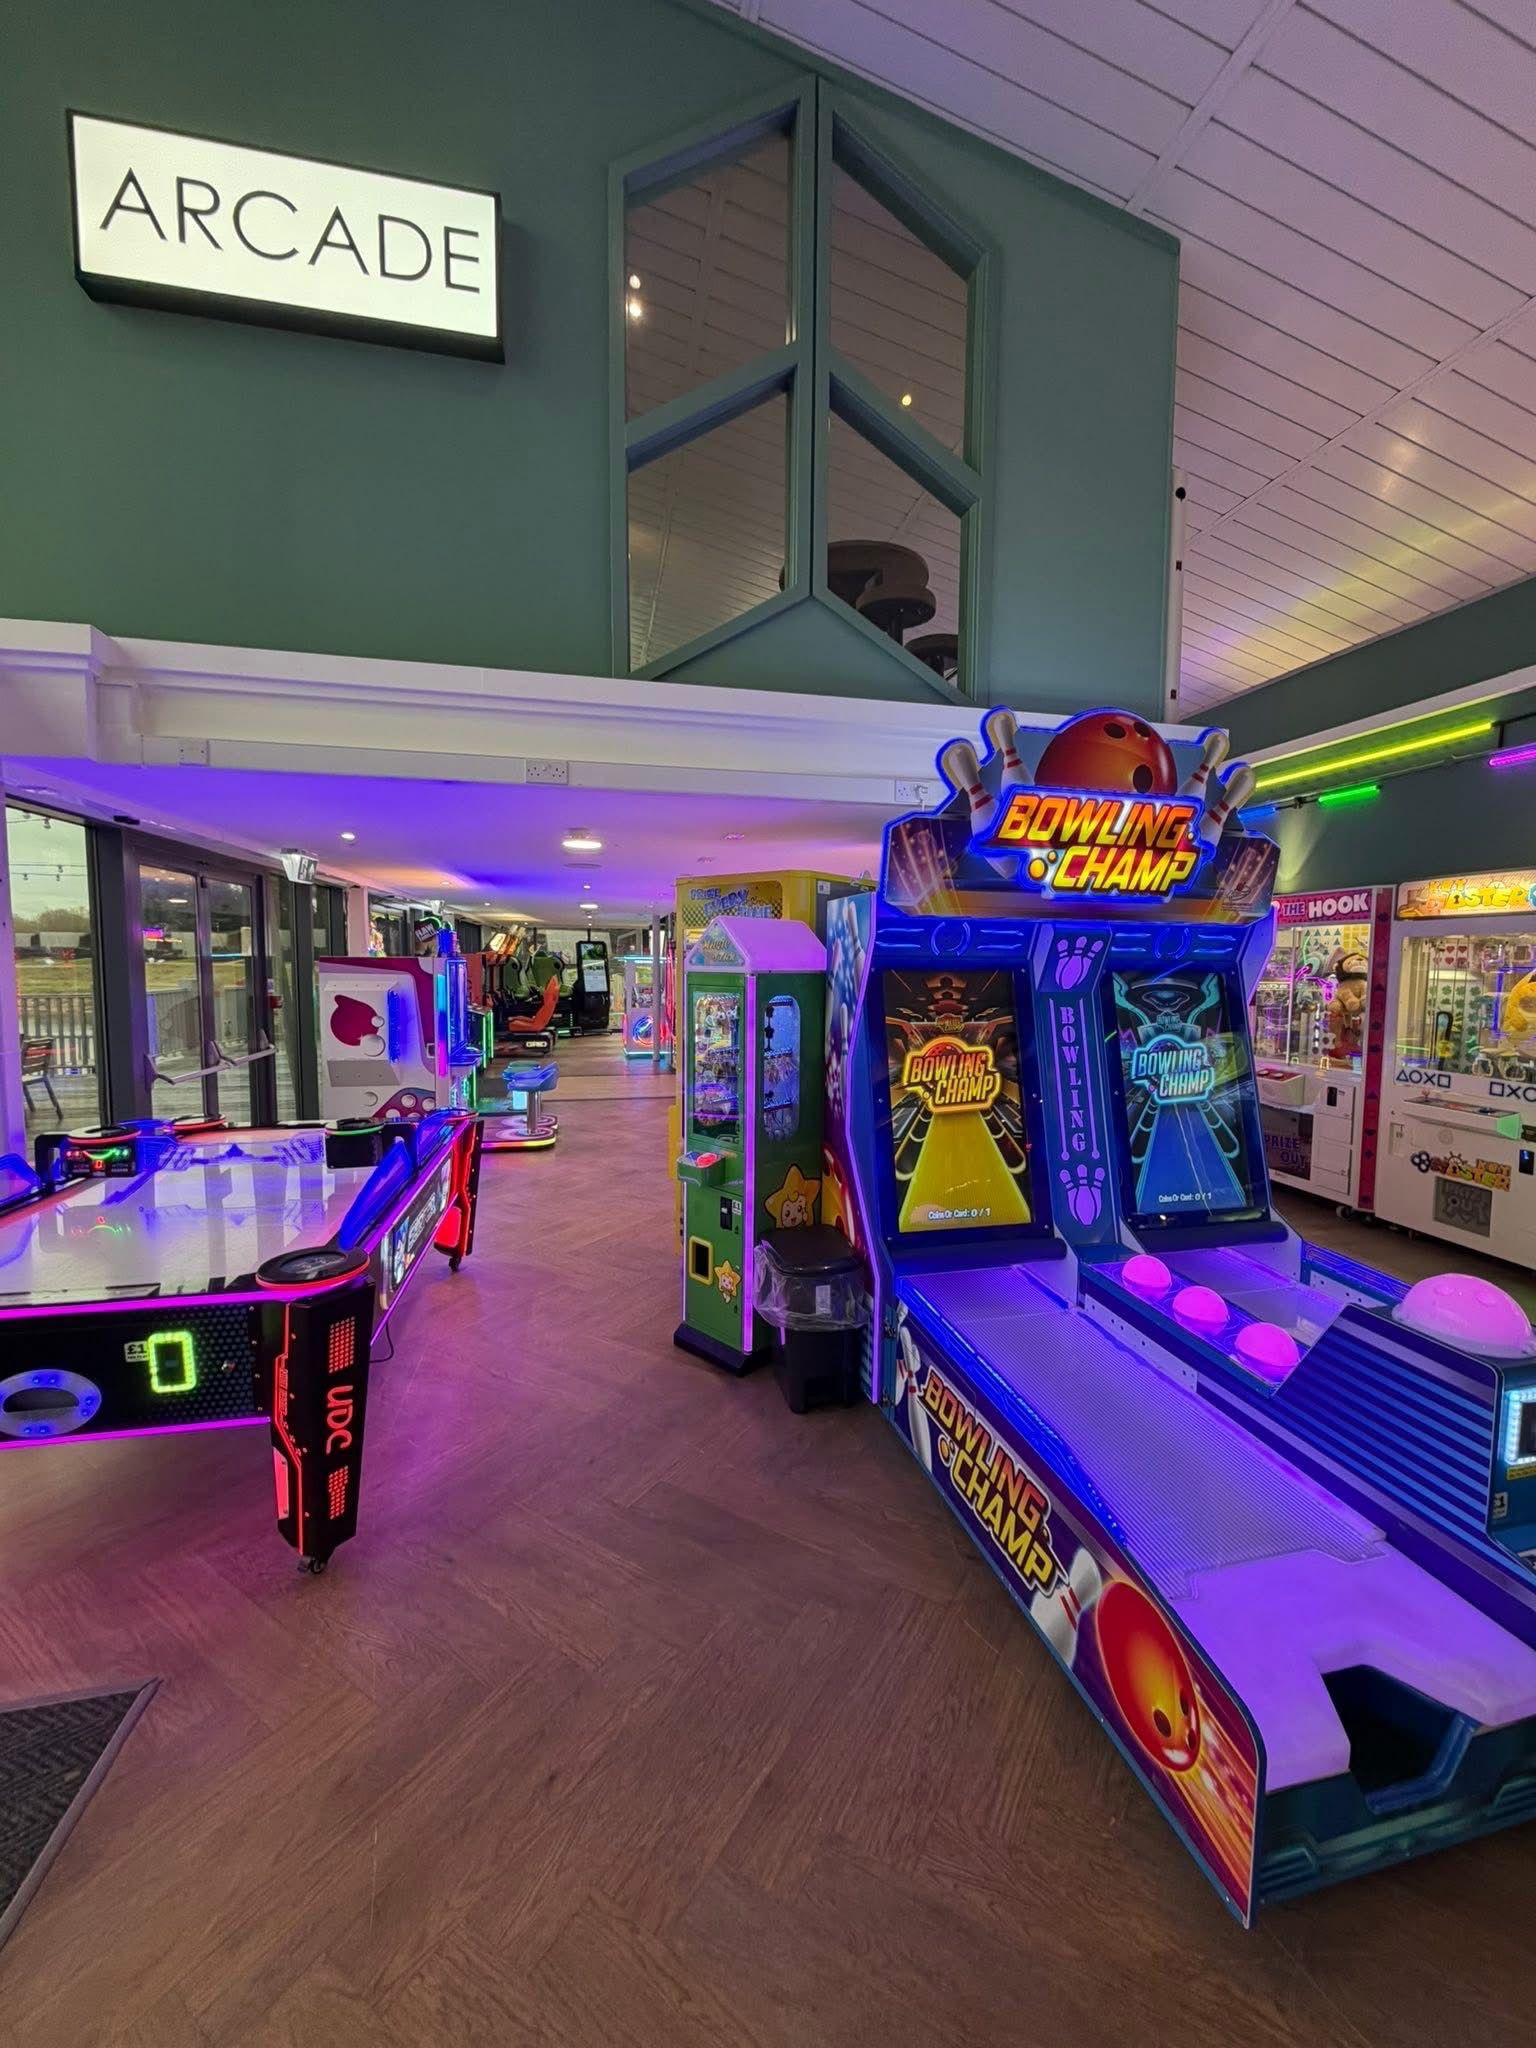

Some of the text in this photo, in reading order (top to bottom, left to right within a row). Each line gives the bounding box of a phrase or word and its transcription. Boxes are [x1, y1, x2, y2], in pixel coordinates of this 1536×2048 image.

[99, 167, 481, 293] ARCADE
[996, 794, 1195, 849] BOWLING
[1052, 845, 1198, 892] CHAMP
[1283, 893, 1368, 919] THE HOOK
[910, 1052, 987, 1083] BOWLING
[1137, 1048, 1202, 1077] BOWLING
[935, 1074, 994, 1105] CHAMP
[1060, 1006, 1087, 1152] BOWLING
[1160, 1069, 1209, 1097] CHAMP
[1264, 1135, 1300, 1152] PRIZE
[1280, 1150, 1305, 1168] OUT
[985, 1207, 991, 1216] 1
[127, 1344, 147, 1355] £1
[148, 1331, 197, 1393] 0
[924, 1374, 1047, 1533] BOWLING
[952, 1449, 1053, 1584] CHAMP
